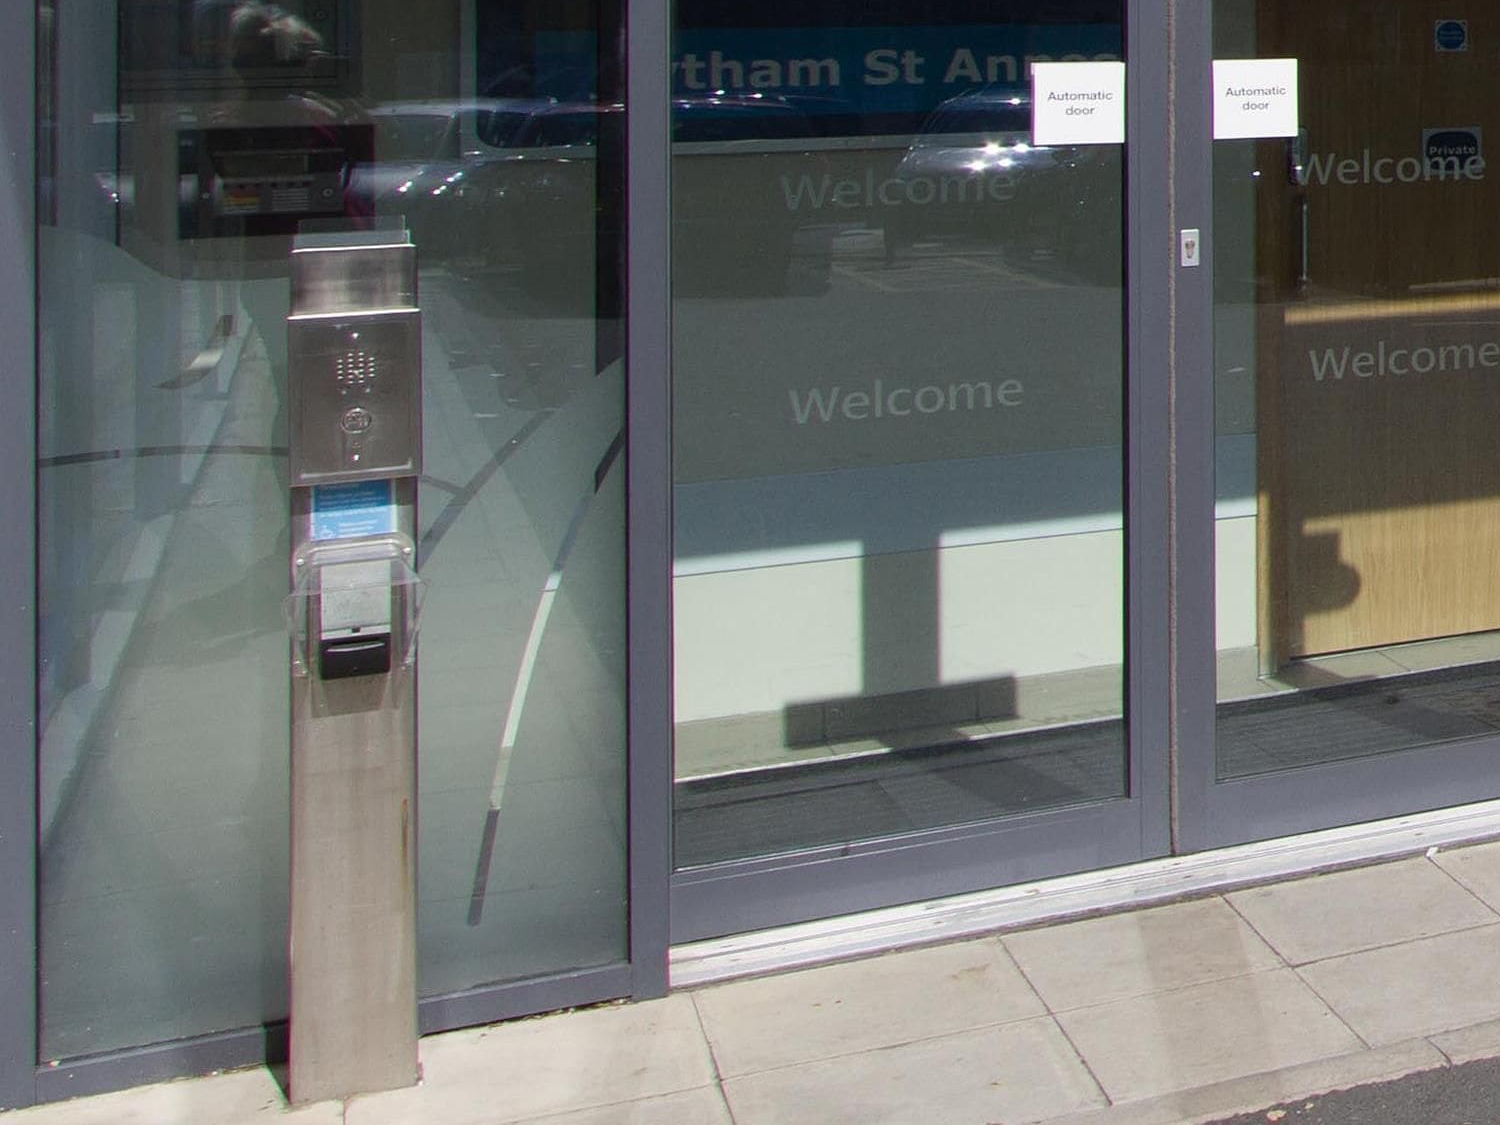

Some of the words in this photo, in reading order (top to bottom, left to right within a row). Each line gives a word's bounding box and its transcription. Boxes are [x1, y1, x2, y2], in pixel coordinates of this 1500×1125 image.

[863, 48, 926, 87] St
[1047, 91, 1113, 101] Automatic
[1225, 86, 1287, 97] Automatic
[1065, 105, 1095, 116] door
[1242, 101, 1270, 111] door
[1429, 145, 1476, 156] Private
[1296, 149, 1486, 186] Welcome
[780, 169, 1018, 211] Welcome
[1309, 341, 1500, 381] Welcome
[788, 378, 1025, 425] Welcome
